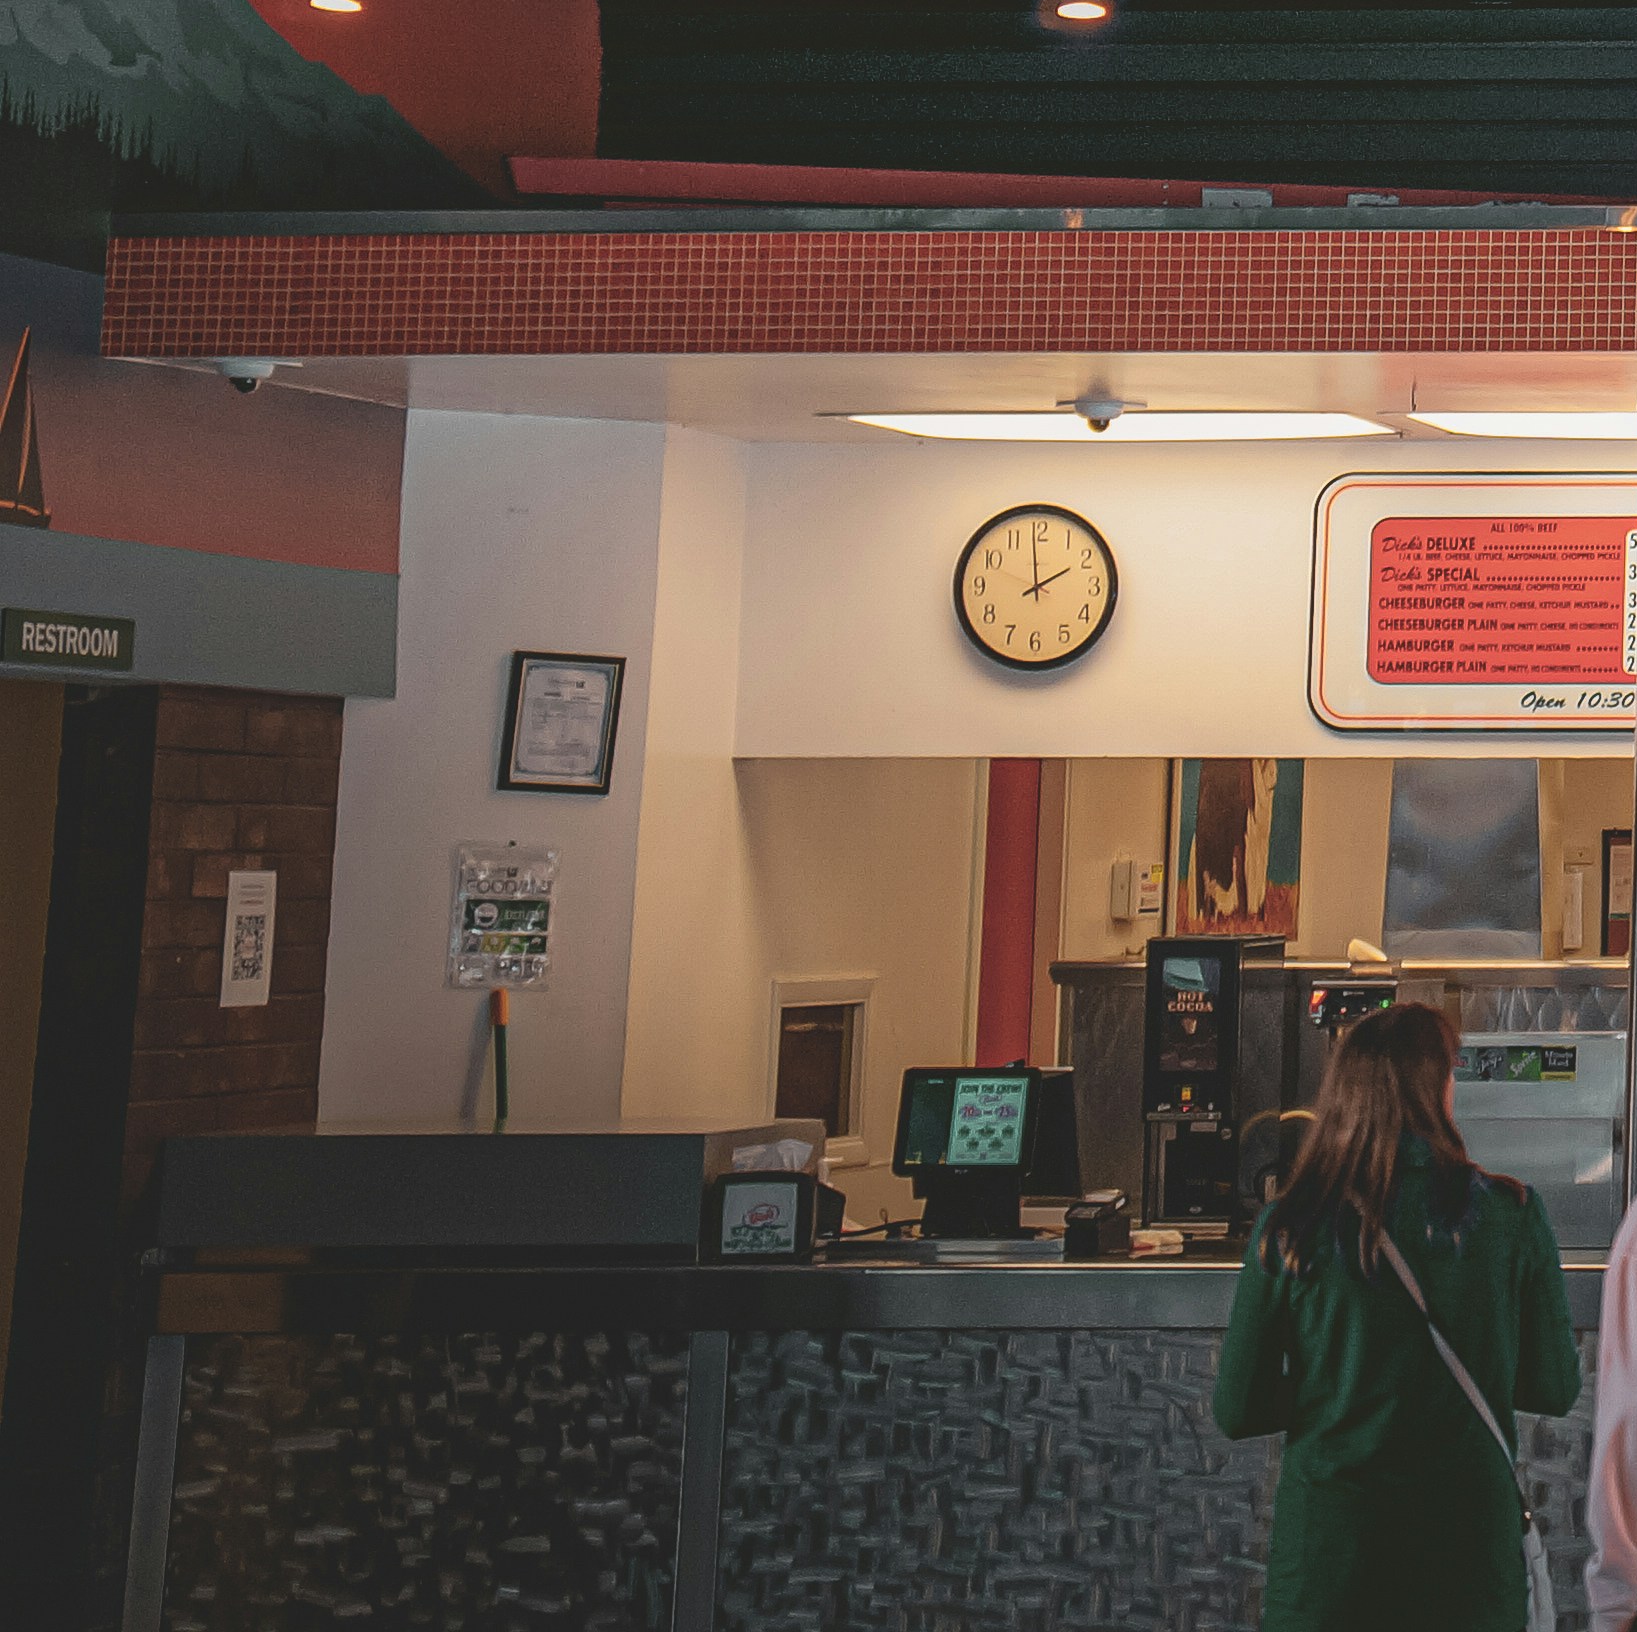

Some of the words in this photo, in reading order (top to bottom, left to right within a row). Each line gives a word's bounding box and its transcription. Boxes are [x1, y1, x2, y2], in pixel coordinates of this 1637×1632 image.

[1008, 529, 1019, 550] 11
[1382, 536, 1422, 554] Dick's
[1427, 537, 1475, 554] DELUXE
[985, 549, 1003, 570] 10
[1081, 548, 1092, 569] 2
[1381, 566, 1422, 582] Dick's
[1427, 568, 1480, 582] SPECIAL
[974, 575, 985, 596] 9
[1088, 576, 1100, 597] 3
[983, 603, 996, 624] 8
[1078, 603, 1090, 624] 4
[1379, 597, 1465, 609] CHEESEBURGER
[1005, 624, 1016, 645] 7
[1058, 624, 1071, 644] 5
[1378, 618, 1464, 631] CHEESEBURGER
[1468, 619, 1497, 630] PLAIN
[22, 621, 119, 658] RESTROOM
[1029, 631, 1041, 652] 6
[1378, 640, 1454, 652] HAMBURGER
[1377, 661, 1453, 672] HAMBURGER
[1456, 661, 1486, 672] PLAIN
[1521, 691, 1565, 712] Open
[1577, 692, 1635, 708] 10:30
[1166, 1000, 1215, 1014] COCOA
[1176, 990, 1207, 1004] HOT
